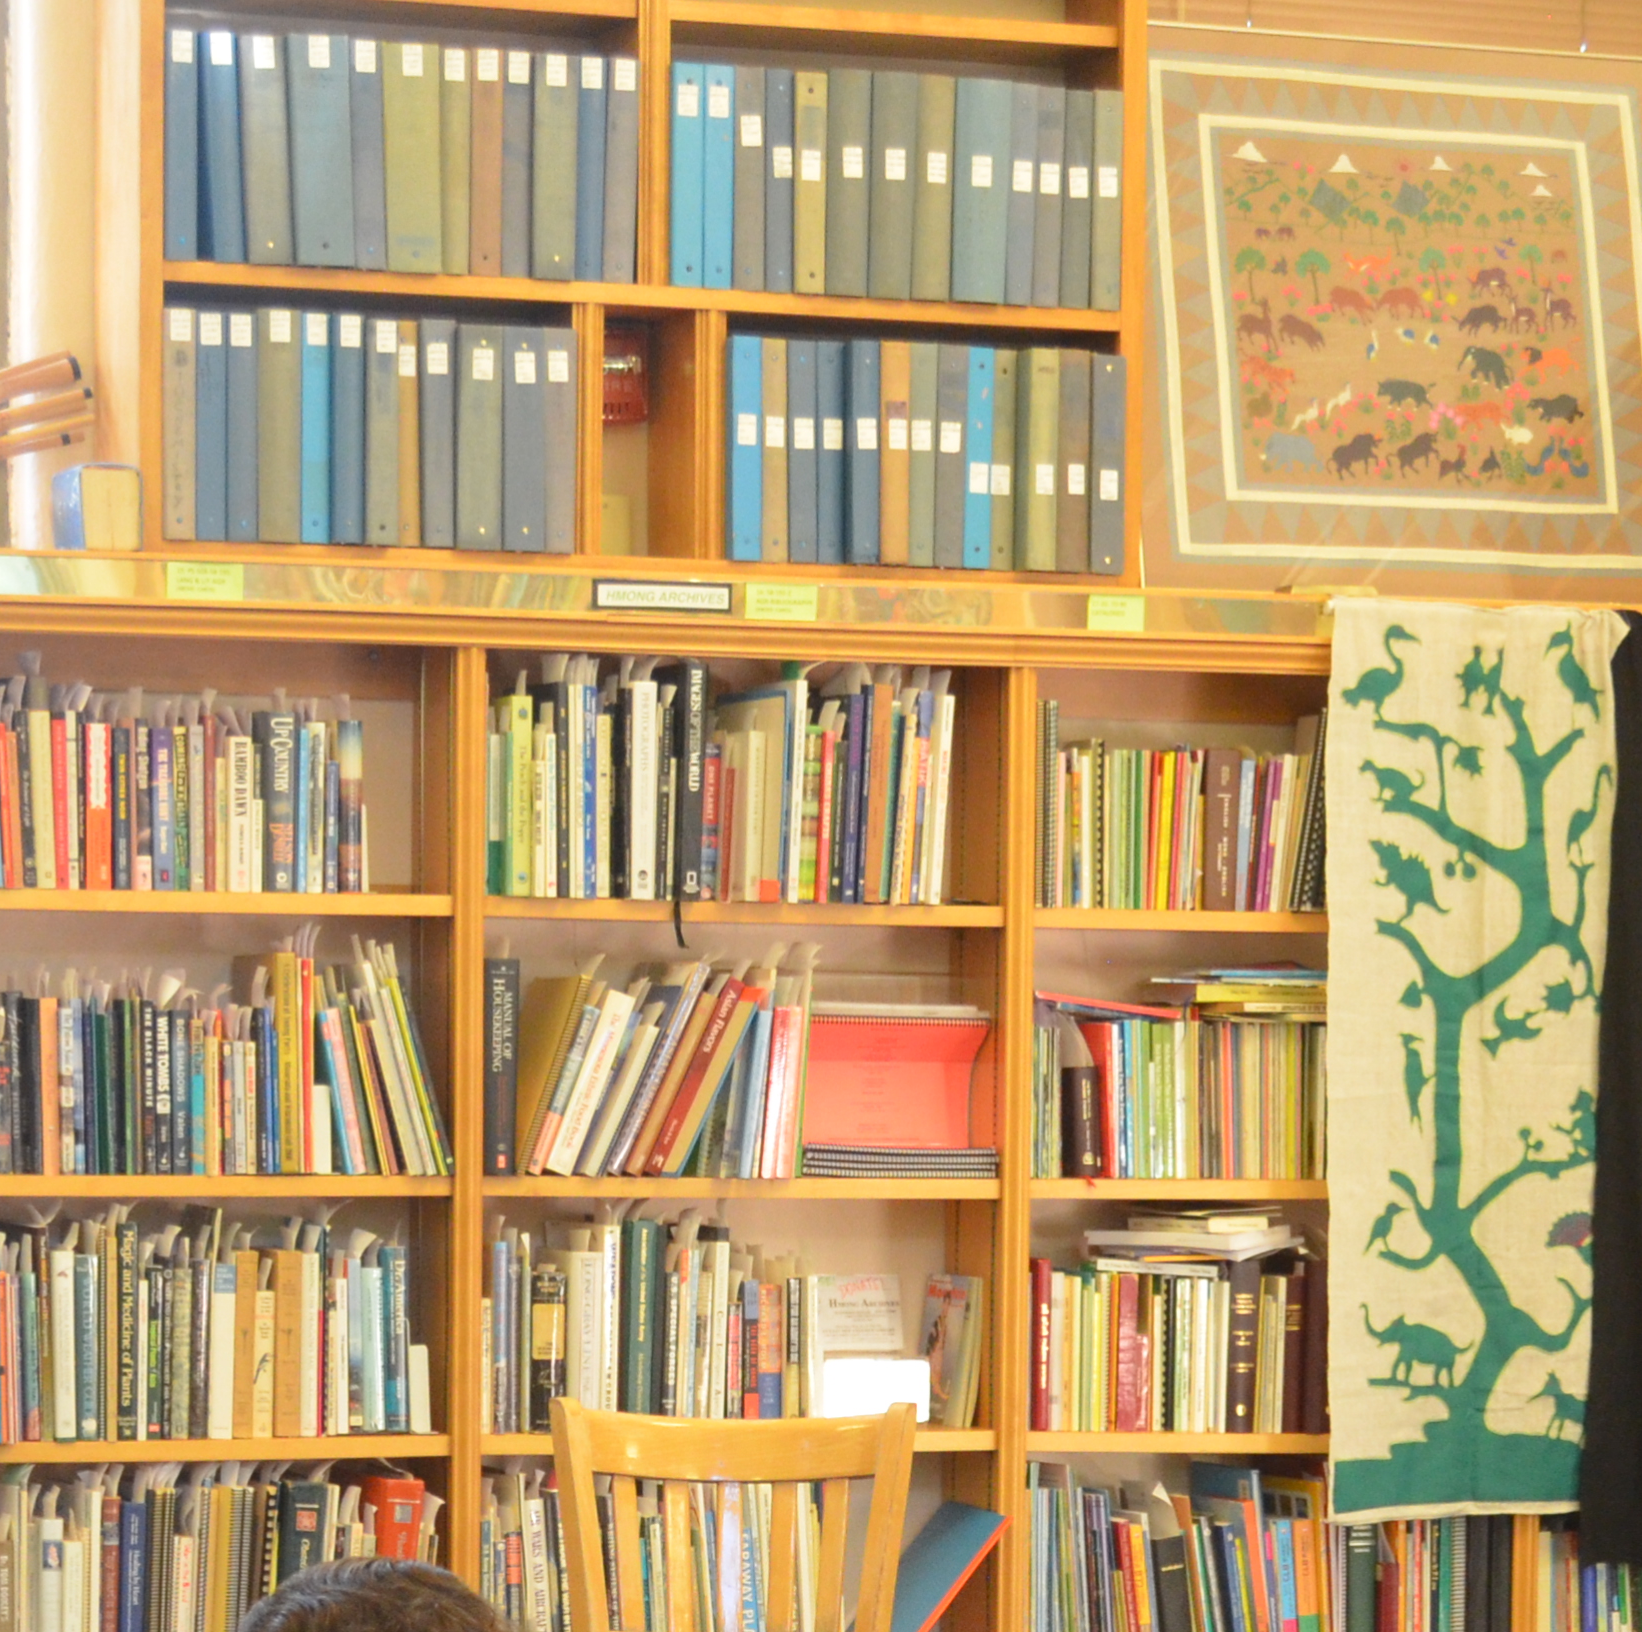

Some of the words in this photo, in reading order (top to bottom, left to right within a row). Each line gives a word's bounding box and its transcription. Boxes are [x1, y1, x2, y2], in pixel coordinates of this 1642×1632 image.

[603, 380, 633, 393] IRE
[607, 591, 655, 602] HMONG
[659, 592, 725, 604] ARCHIVES
[688, 669, 704, 711] IMAGES
[640, 692, 650, 771] PHOTOGRAPHS
[689, 712, 701, 726] OF
[175, 735, 186, 769] COMING
[519, 746, 528, 761] The
[689, 726, 700, 752] THE
[136, 756, 148, 790] Shotgun
[234, 742, 248, 785] BAMBOO
[273, 737, 293, 793] COUNTRY
[519, 763, 528, 786] Peach
[688, 752, 700, 792] WORLD
[918, 740, 929, 784] BATIK
[234, 788, 248, 817] DAWN
[705, 785, 714, 821] PLANET
[502, 991, 513, 1040] MANUAL
[717, 989, 738, 1018] Asian
[157, 1016, 169, 1052] WHITE
[176, 1019, 185, 1047] BONE
[491, 978, 506, 1073] HOUSEKEEPING
[701, 1018, 725, 1054] Flavors
[503, 1042, 513, 1060] OF
[593, 1031, 618, 1075] Minnesota
[145, 1068, 154, 1107] MINUTE
[158, 1054, 170, 1092] TOMBS
[176, 1050, 186, 1102] SHADOWS
[583, 1076, 601, 1101] Ethnic
[177, 1111, 186, 1138] Valen
[572, 1102, 592, 1127] Food
[565, 1127, 582, 1150] Book
[119, 1230, 135, 1267] Magic
[123, 1270, 134, 1293] and
[395, 1259, 406, 1282] Dr.
[122, 1295, 134, 1351] Medicine
[395, 1284, 405, 1334] America
[668, 1299, 677, 1342] SPECIAL
[122, 1353, 134, 1366] of
[121, 1368, 134, 1407] Plants
[533, 1531, 544, 1558] WARS
[534, 1563, 545, 1583] AND
